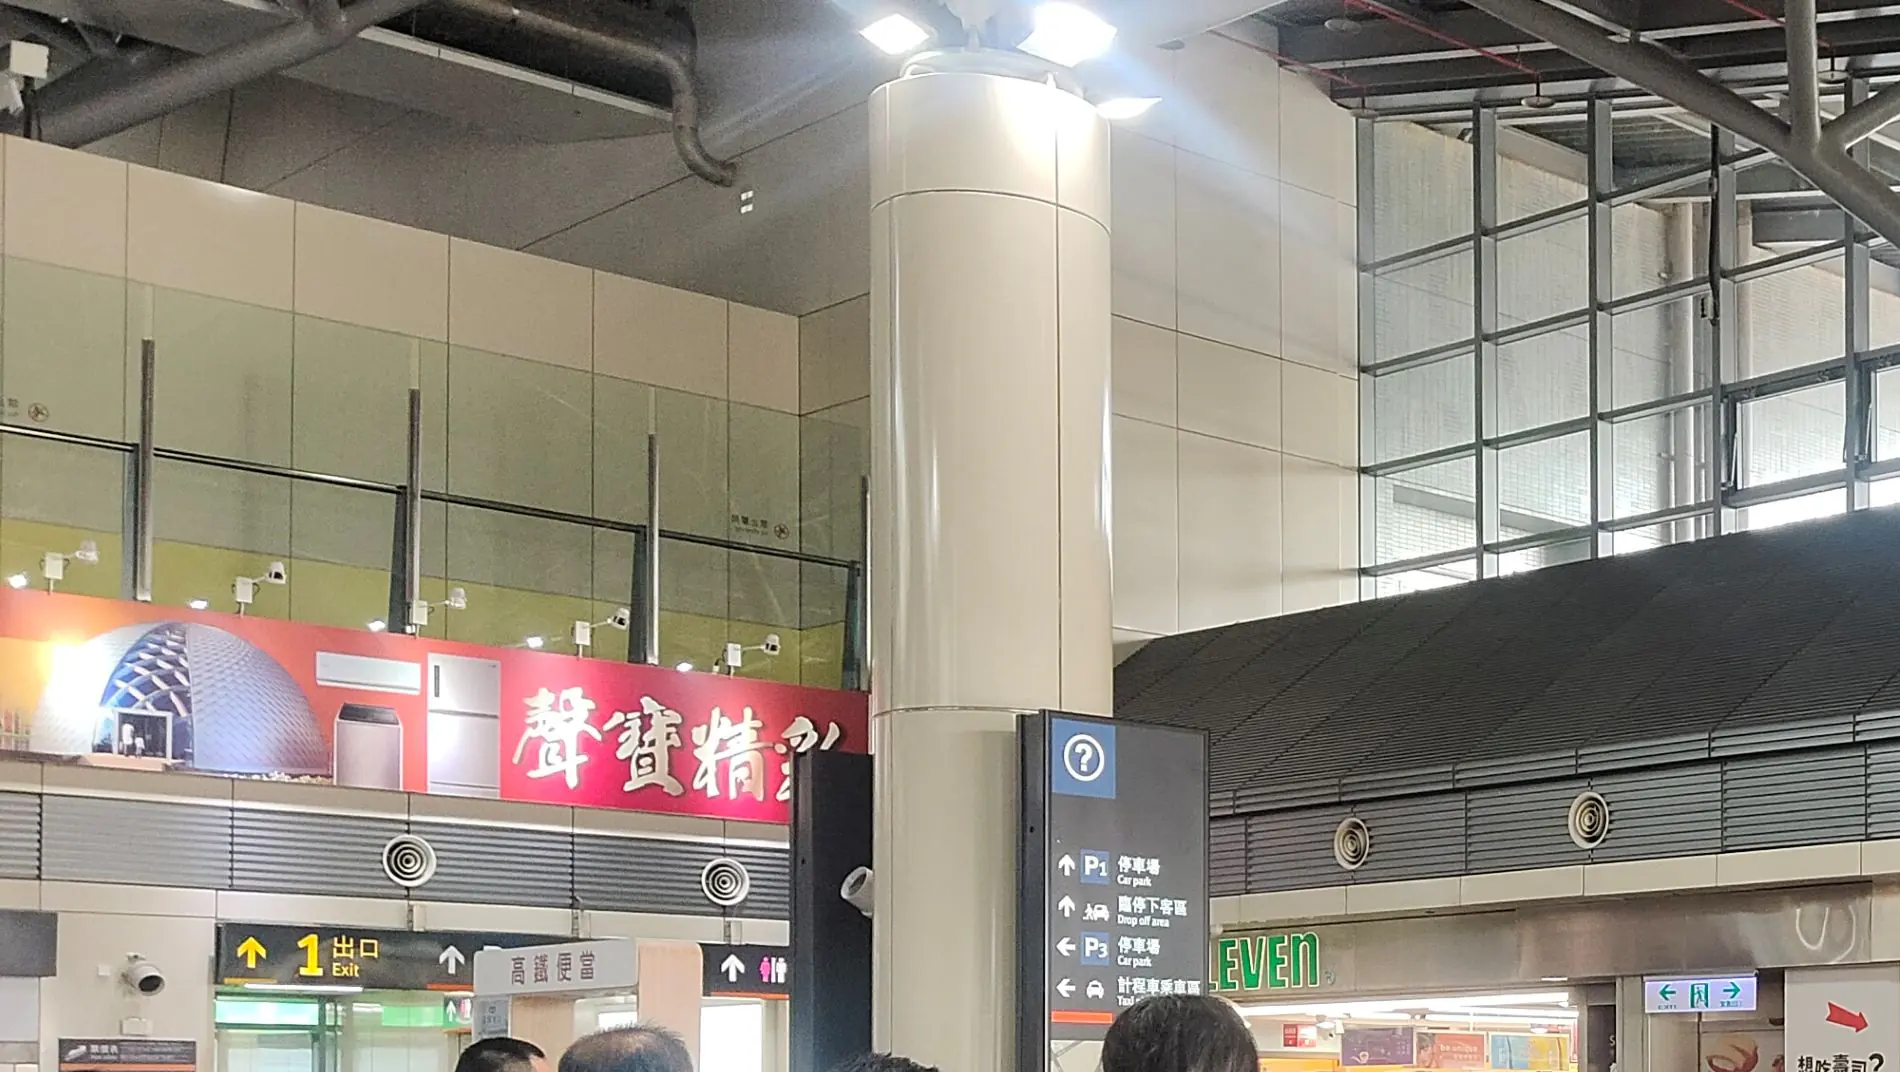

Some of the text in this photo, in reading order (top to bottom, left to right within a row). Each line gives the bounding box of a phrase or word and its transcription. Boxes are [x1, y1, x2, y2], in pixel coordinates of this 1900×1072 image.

[1084, 855, 1108, 877] P1
[1118, 855, 1161, 876] 停車場
[1117, 875, 1152, 888] Car park
[1118, 895, 1188, 917] 臨停下客區
[1117, 914, 1170, 928] Drop off area
[297, 933, 324, 977] 1
[332, 934, 379, 959] 出口
[1084, 936, 1109, 959] P3
[1118, 935, 1161, 956] 停車場
[332, 962, 360, 978] Exit
[511, 950, 596, 986] 高鐵便當
[1117, 955, 1152, 968] Car park
